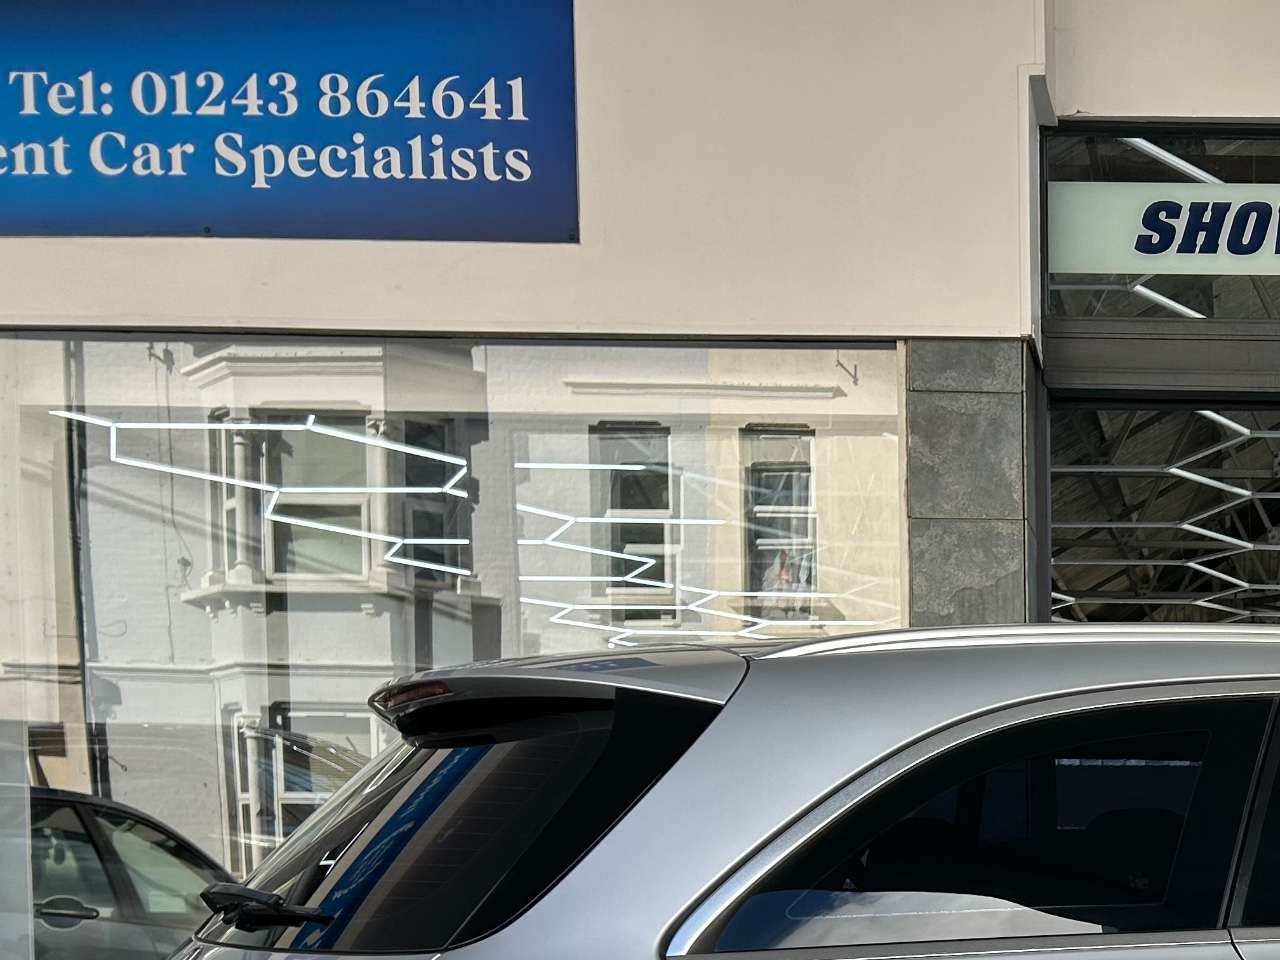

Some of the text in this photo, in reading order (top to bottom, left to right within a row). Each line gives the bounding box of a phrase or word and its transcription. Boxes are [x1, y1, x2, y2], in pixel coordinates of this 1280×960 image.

[8, 71, 529, 121] Tel: 01243 864641
[89, 131, 195, 176] Car
[214, 132, 532, 189] Specialists
